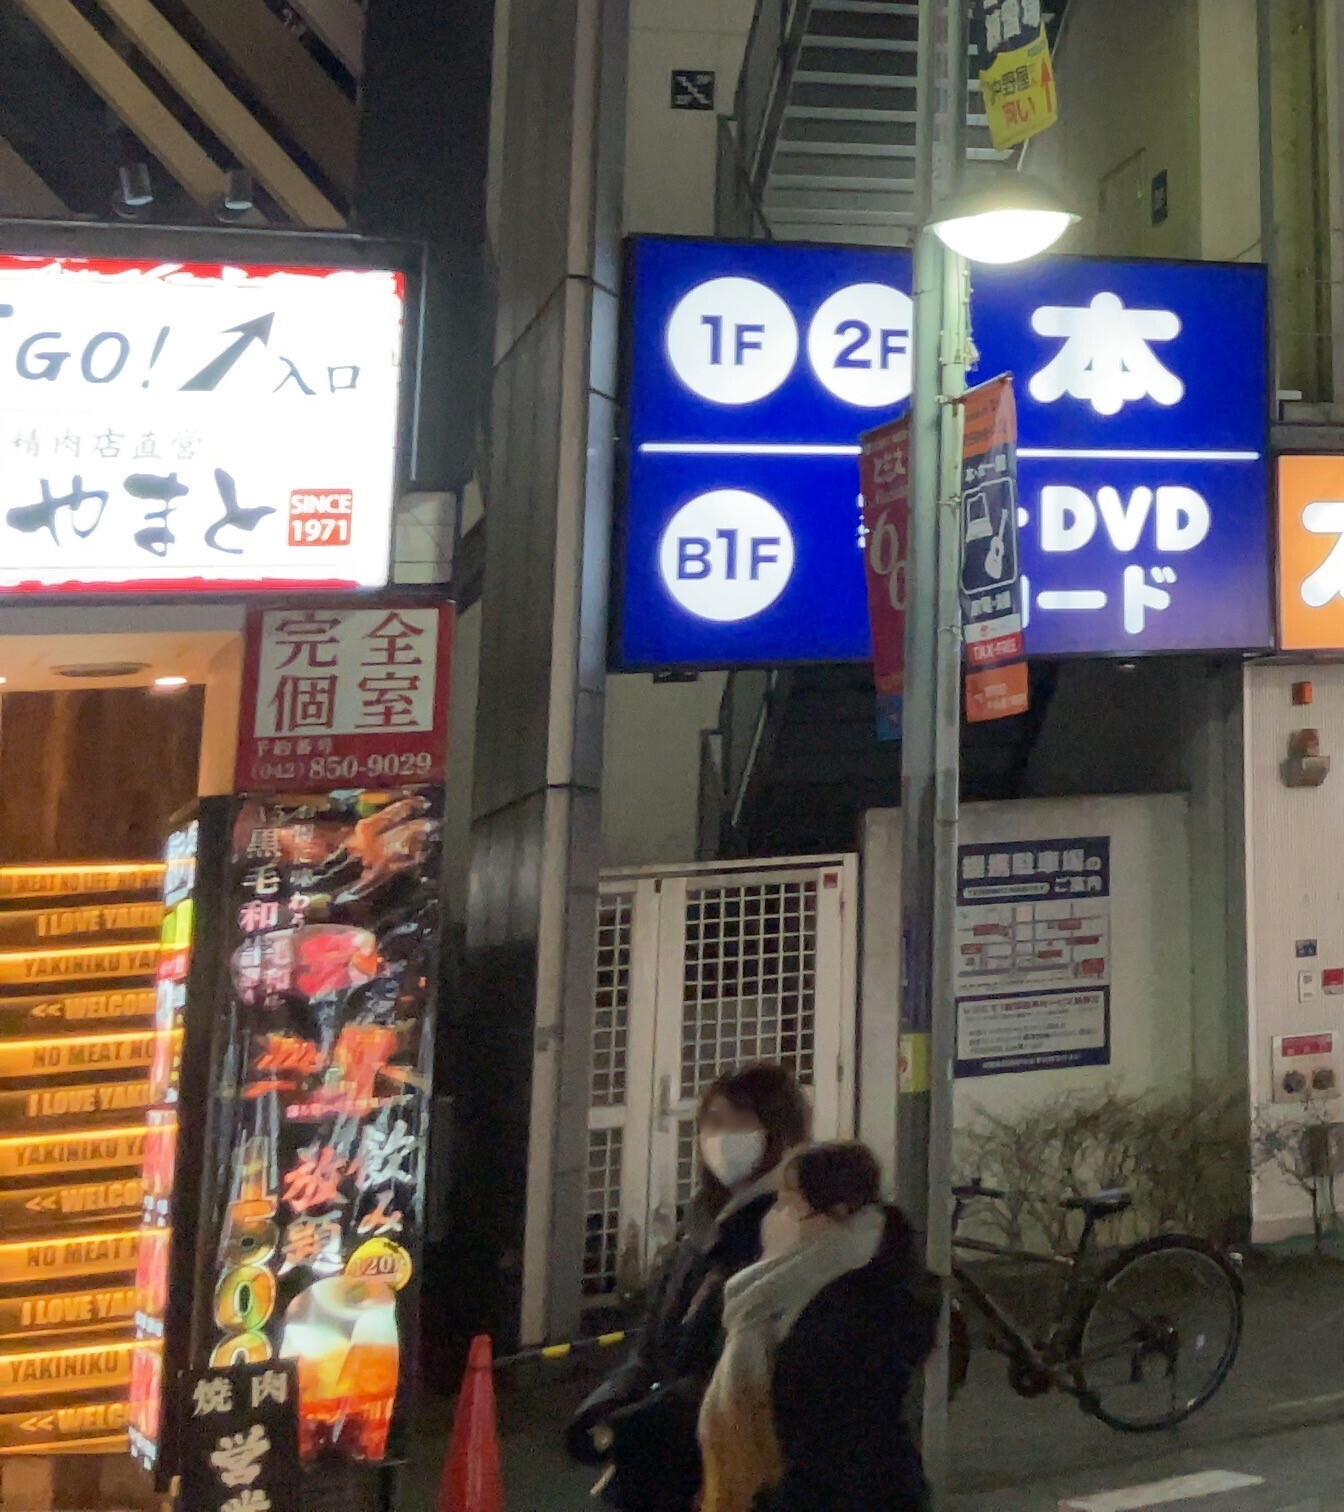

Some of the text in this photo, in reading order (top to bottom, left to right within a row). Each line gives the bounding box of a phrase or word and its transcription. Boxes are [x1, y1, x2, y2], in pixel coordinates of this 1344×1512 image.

[15, 325, 171, 389] GO!
[700, 314, 912, 371] 1F 2F
[1027, 291, 1186, 418] 本
[272, 355, 362, 396] 入口
[5, 466, 278, 558] やまと
[290, 493, 353, 516] SINCE
[291, 519, 350, 544] 1971
[676, 526, 782, 582] B1F
[272, 609, 423, 672] 完全
[266, 670, 422, 733] 個室
[192, 1369, 289, 1420] 焼肉
